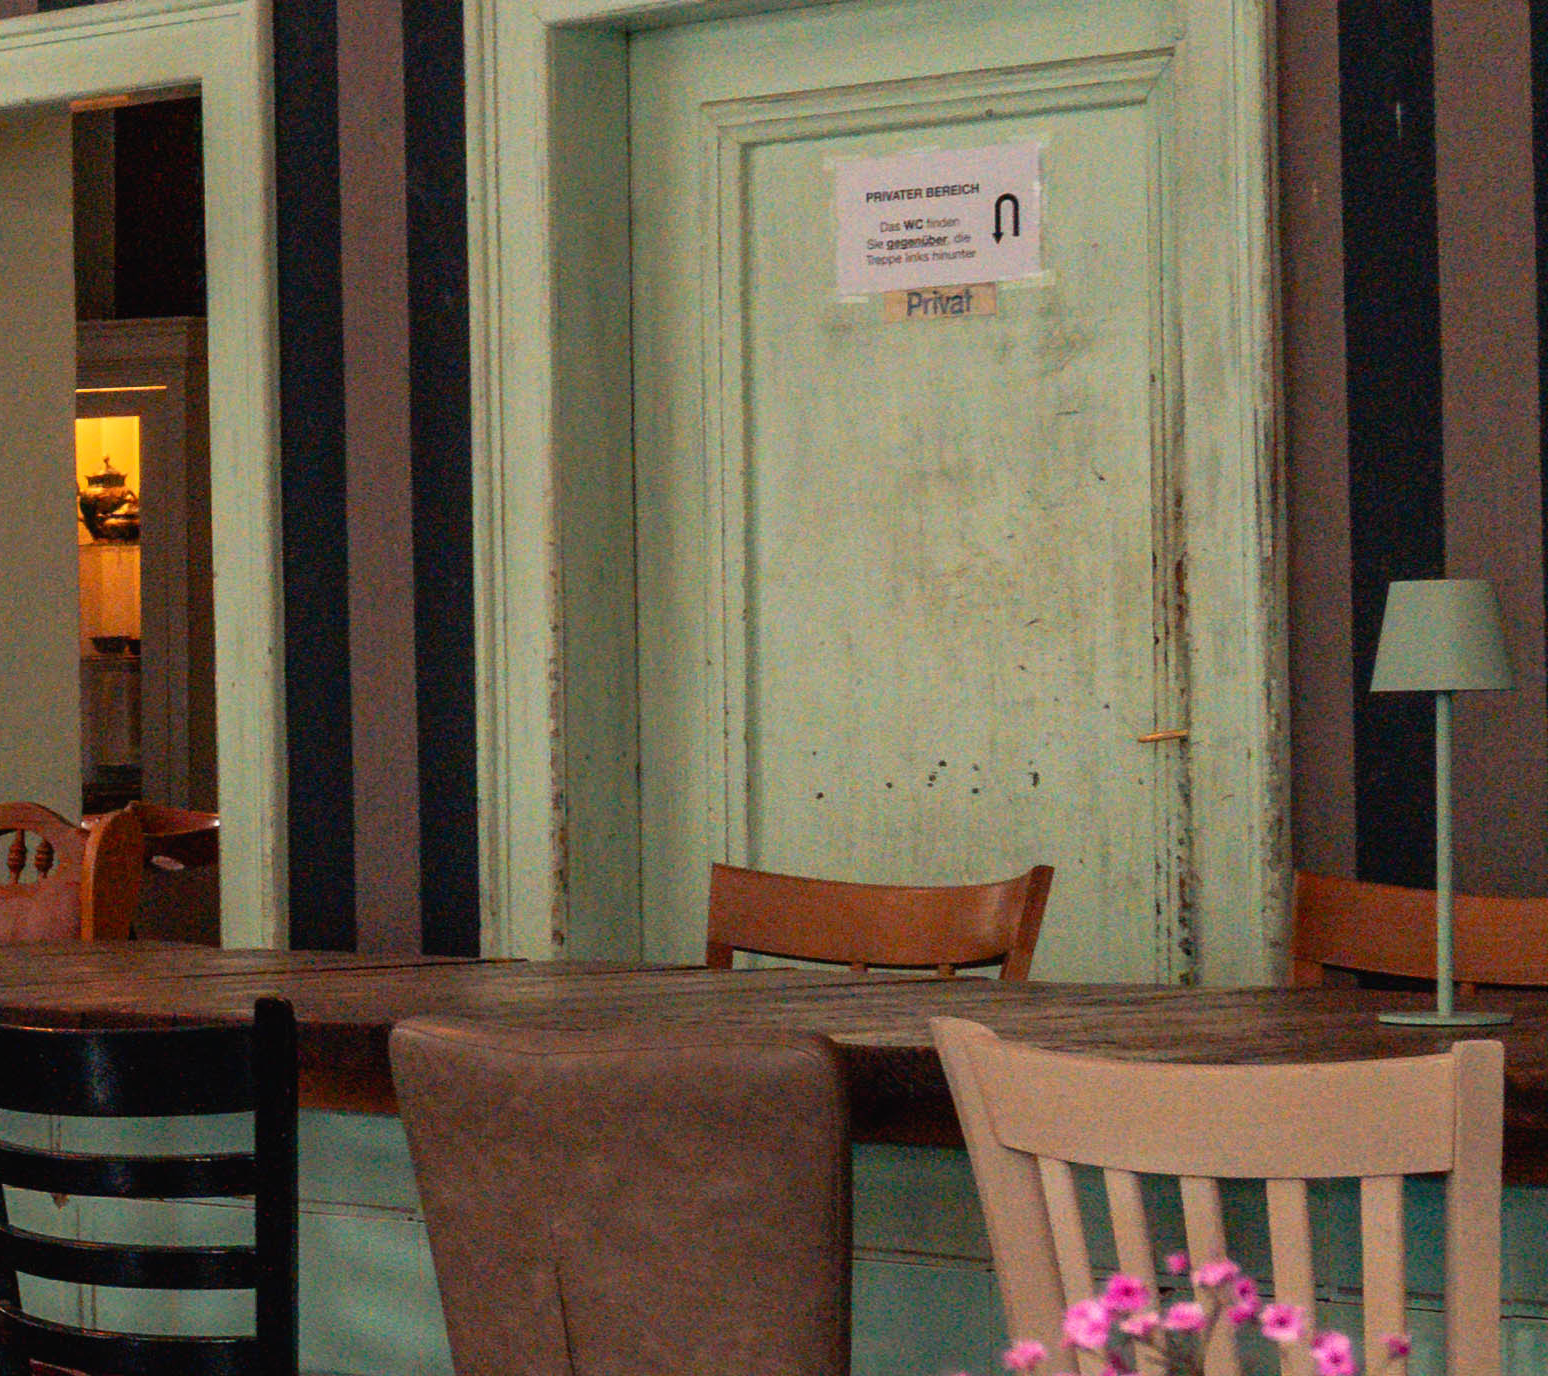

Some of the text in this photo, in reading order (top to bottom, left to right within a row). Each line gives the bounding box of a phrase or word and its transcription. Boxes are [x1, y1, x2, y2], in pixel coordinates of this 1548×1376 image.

[865, 182, 980, 203] PRIVATER BEREICH
[879, 216, 961, 233] Das WC finden
[866, 248, 977, 267] Treppe links hinunter
[906, 288, 974, 317] Privat
